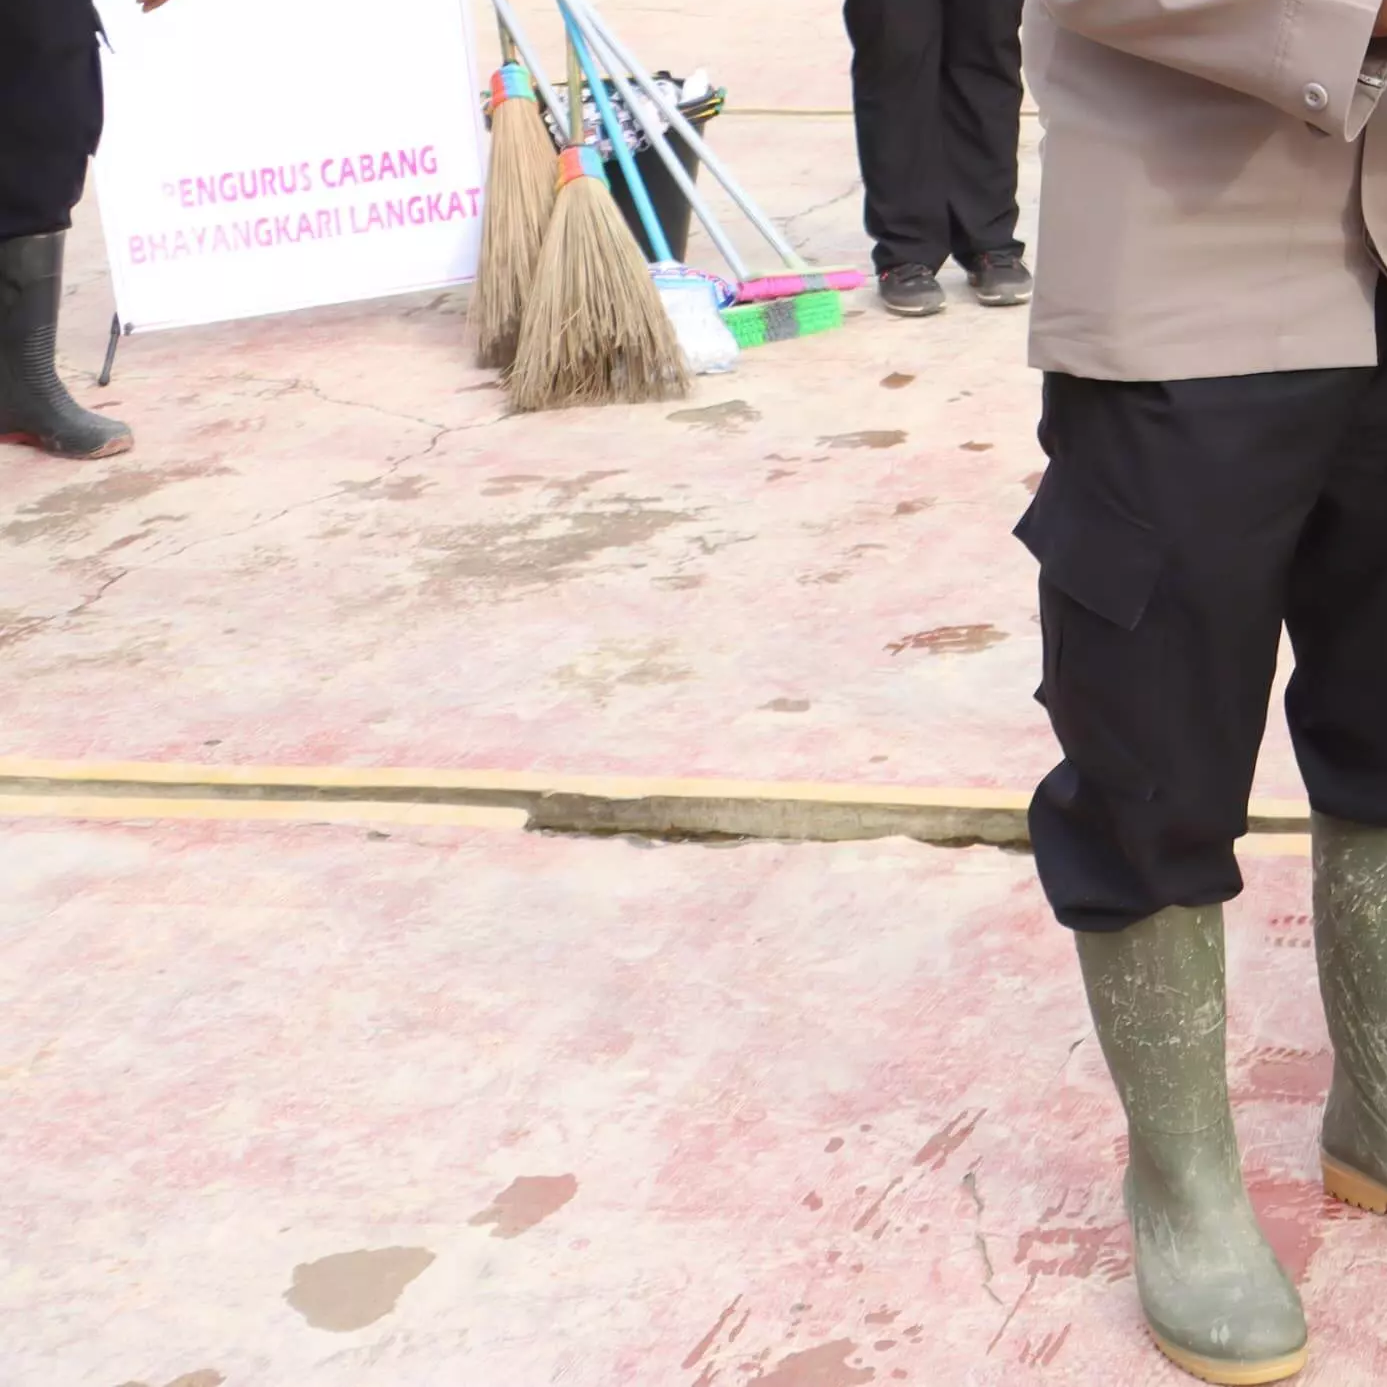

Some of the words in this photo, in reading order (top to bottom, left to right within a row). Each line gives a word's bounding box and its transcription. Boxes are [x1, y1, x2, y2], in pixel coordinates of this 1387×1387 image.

[162, 160, 312, 210] PENGURUS
[320, 145, 438, 190] CABANG
[128, 207, 341, 266] BHAYANGKARI
[350, 186, 482, 234] LANGKAT
